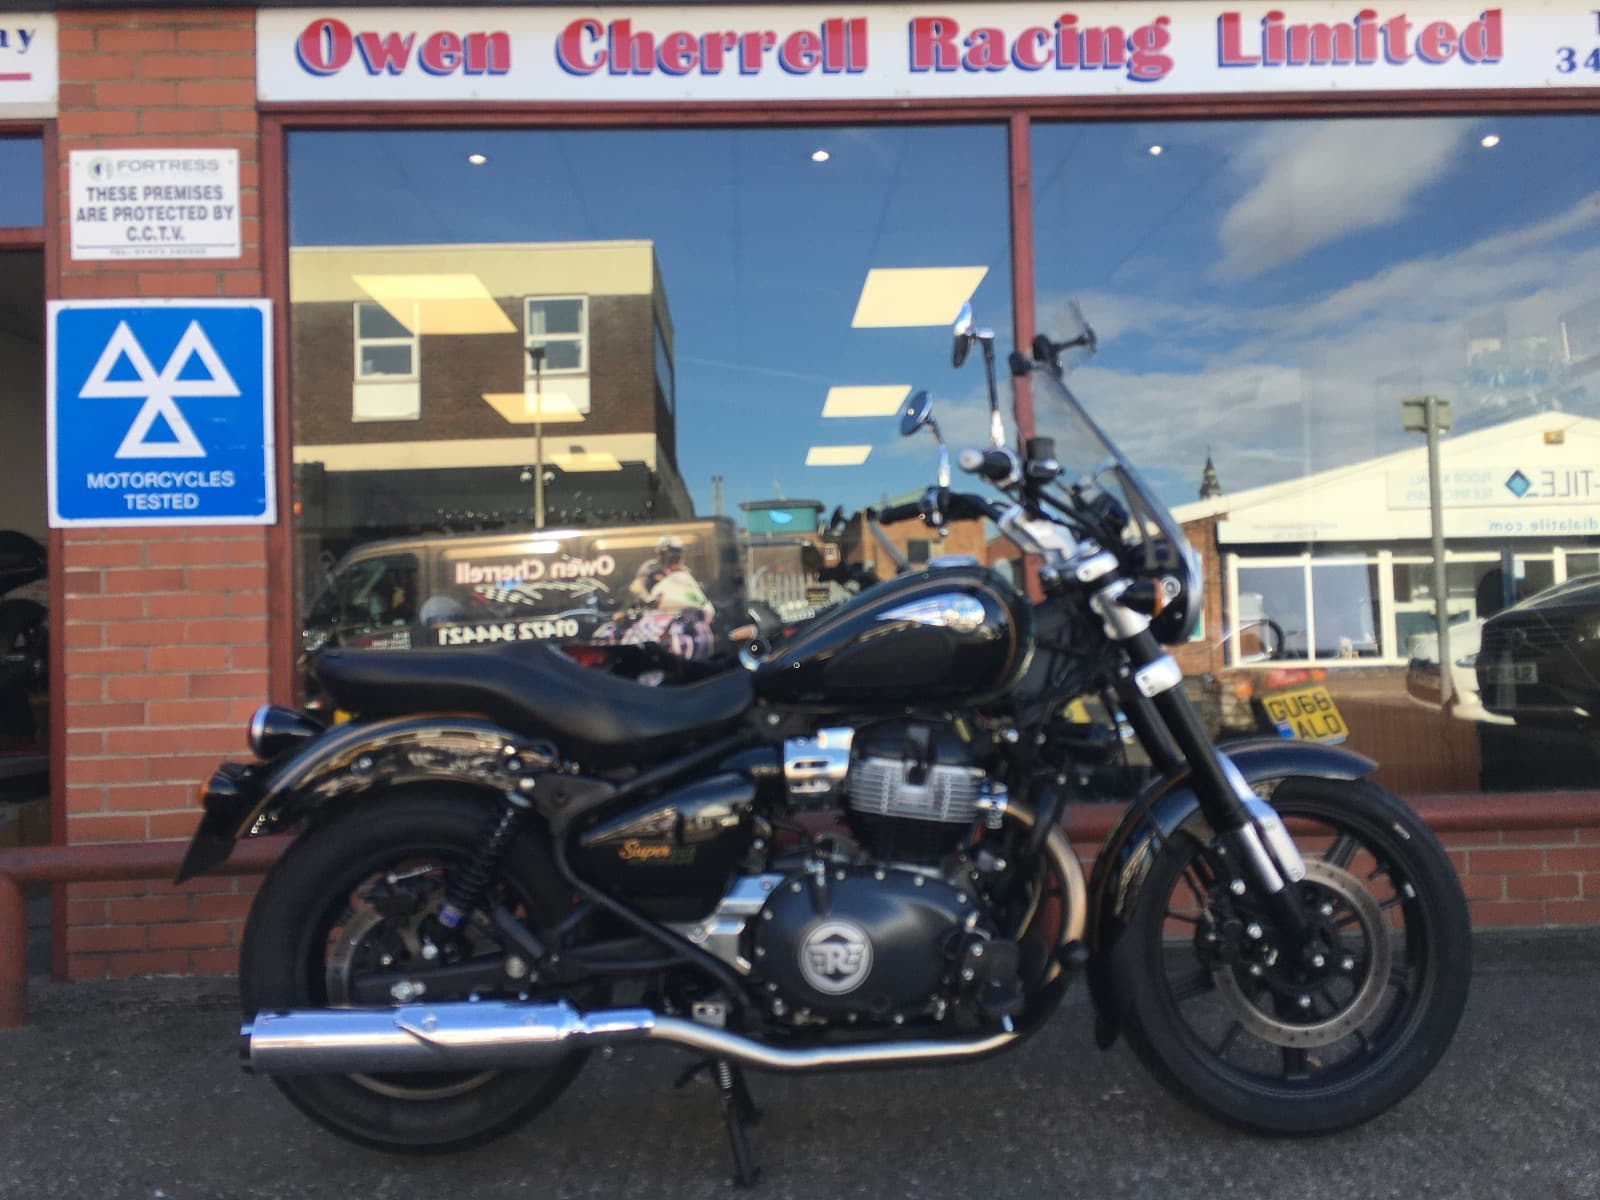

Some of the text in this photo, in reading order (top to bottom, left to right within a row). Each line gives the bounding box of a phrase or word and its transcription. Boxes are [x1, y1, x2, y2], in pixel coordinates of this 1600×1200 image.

[294, 8, 1503, 82] Owen Cherrell Racing Limited
[116, 158, 220, 173] FORTRESS
[86, 184, 224, 202] THESE PREMISES
[76, 205, 235, 222] ARE PROTECTED BY
[126, 226, 186, 242] C.C.T.V.
[86, 470, 236, 489] MOTORCYCLES
[123, 493, 200, 511] TESTED
